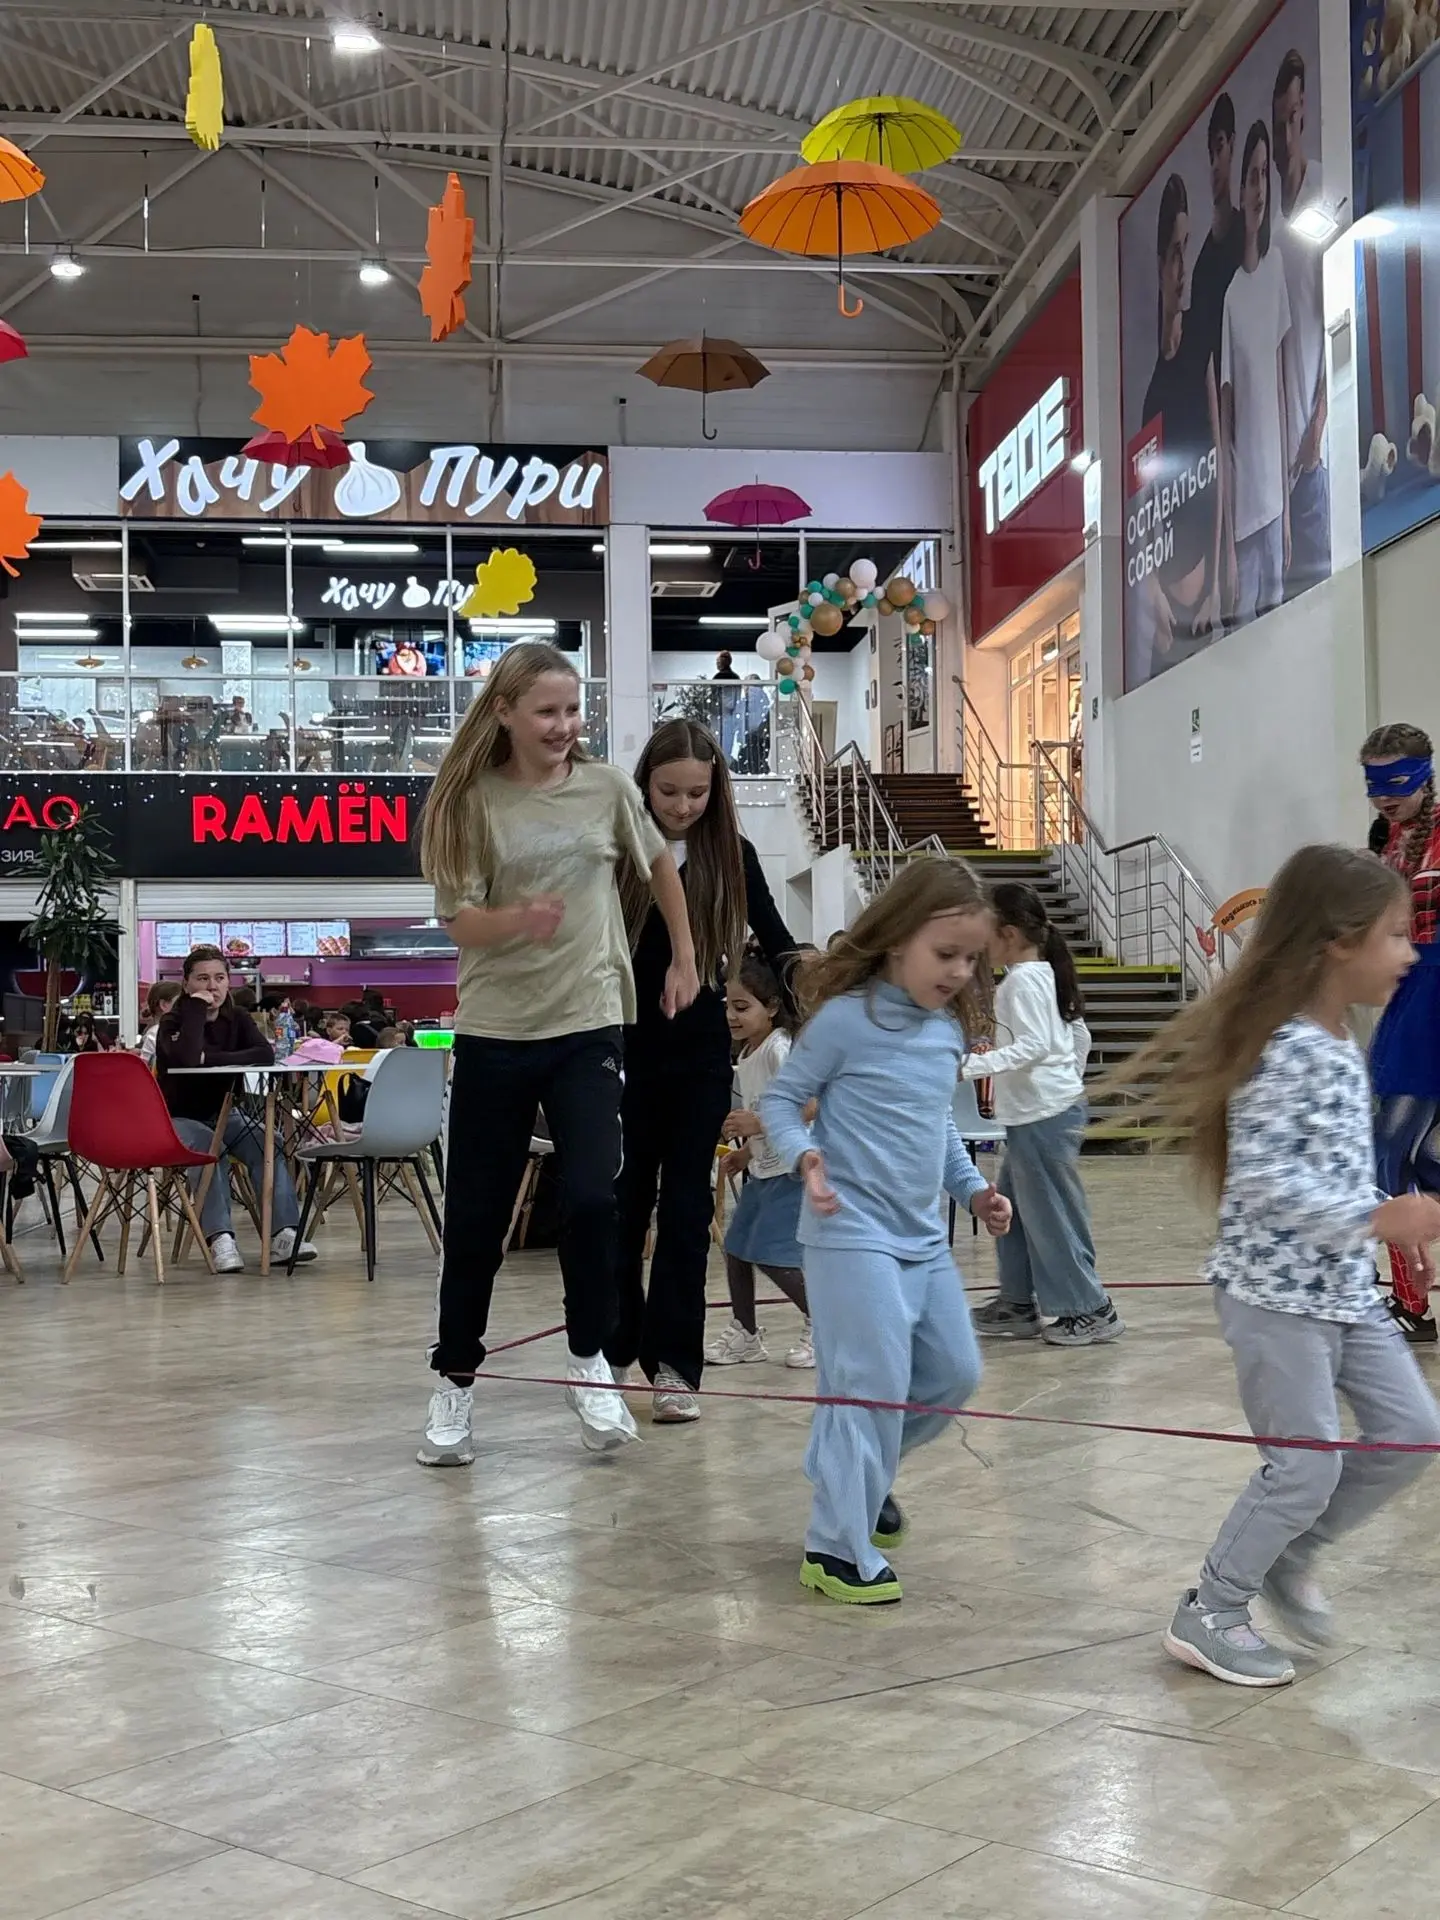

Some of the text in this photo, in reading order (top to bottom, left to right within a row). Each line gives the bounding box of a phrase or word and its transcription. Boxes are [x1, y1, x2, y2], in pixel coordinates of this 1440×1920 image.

[119, 438, 603, 521] Хачу Пури
[978, 375, 1070, 535] ТВОЕ
[1126, 446, 1218, 546] ОСТАВАТЬСЯ
[320, 576, 475, 612] Хачу Пу
[1126, 519, 1175, 588] СОБОЙ
